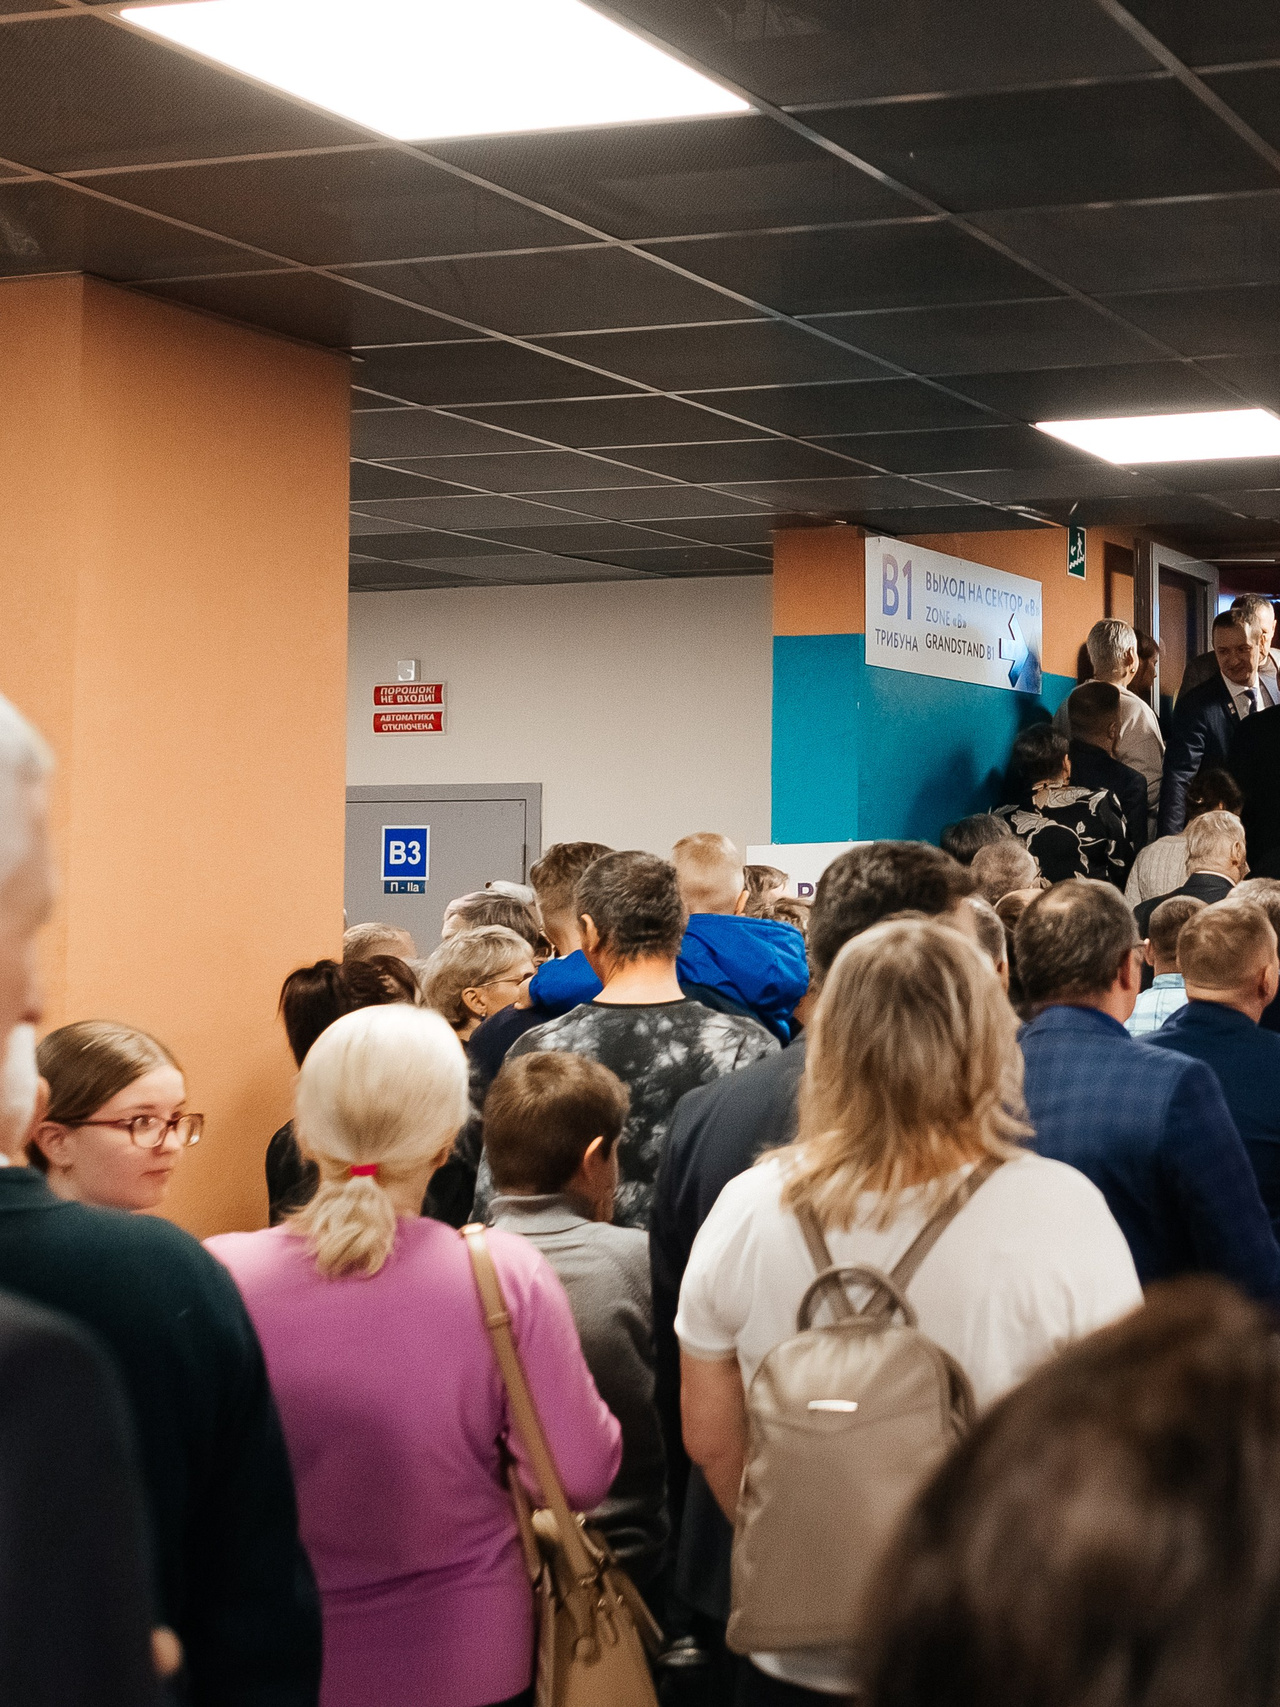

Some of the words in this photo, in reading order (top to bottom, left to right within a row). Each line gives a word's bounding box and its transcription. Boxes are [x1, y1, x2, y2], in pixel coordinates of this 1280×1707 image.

[882, 553, 912, 620] В1
[926, 571, 966, 603] ВЫХОД
[968, 582, 984, 604] НА
[985, 587, 1023, 612] СЕКТОР
[926, 606, 951, 627] ZONE
[875, 628, 919, 653] ТРИБУНА
[925, 632, 985, 660] GRANDSTAND
[986, 644, 995, 660] B1
[380, 686, 436, 695] ПОРОШОК!
[380, 695, 394, 703] НЕ
[397, 694, 435, 703] ВХОДИ!
[380, 713, 435, 722] АВТОМАТИКА
[382, 722, 434, 732] ОТКЛЮЧЕНА
[389, 840, 421, 865] В3
